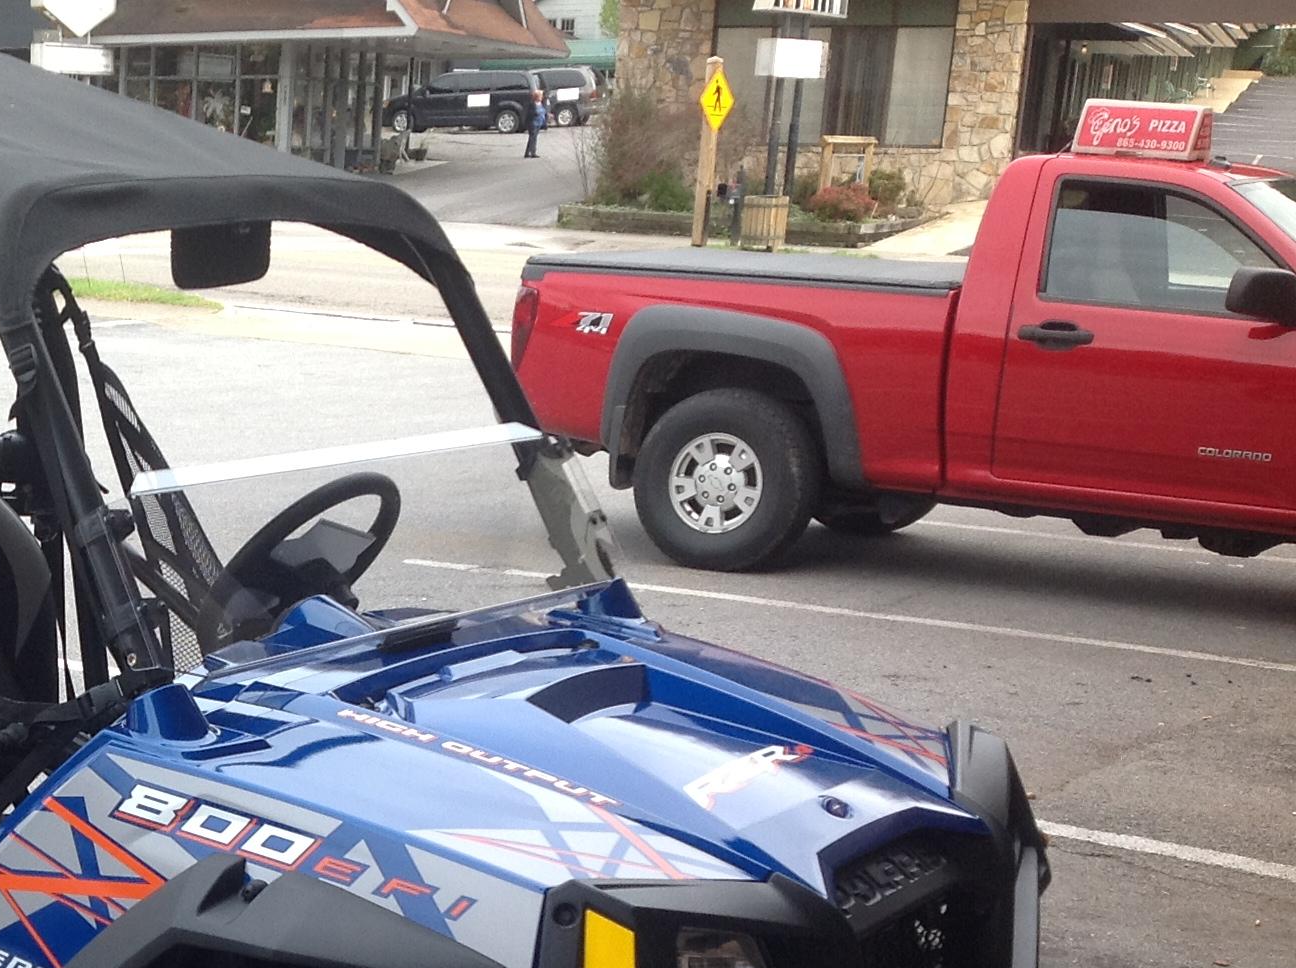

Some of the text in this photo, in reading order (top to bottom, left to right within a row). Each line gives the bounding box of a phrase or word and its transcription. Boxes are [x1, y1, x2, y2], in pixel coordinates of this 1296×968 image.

[1148, 118, 1187, 134] PIZZA
[1197, 446, 1273, 462] COLORADO
[336, 707, 625, 806] HIGH OUTPUT
[112, 783, 470, 916] 800 EFI
